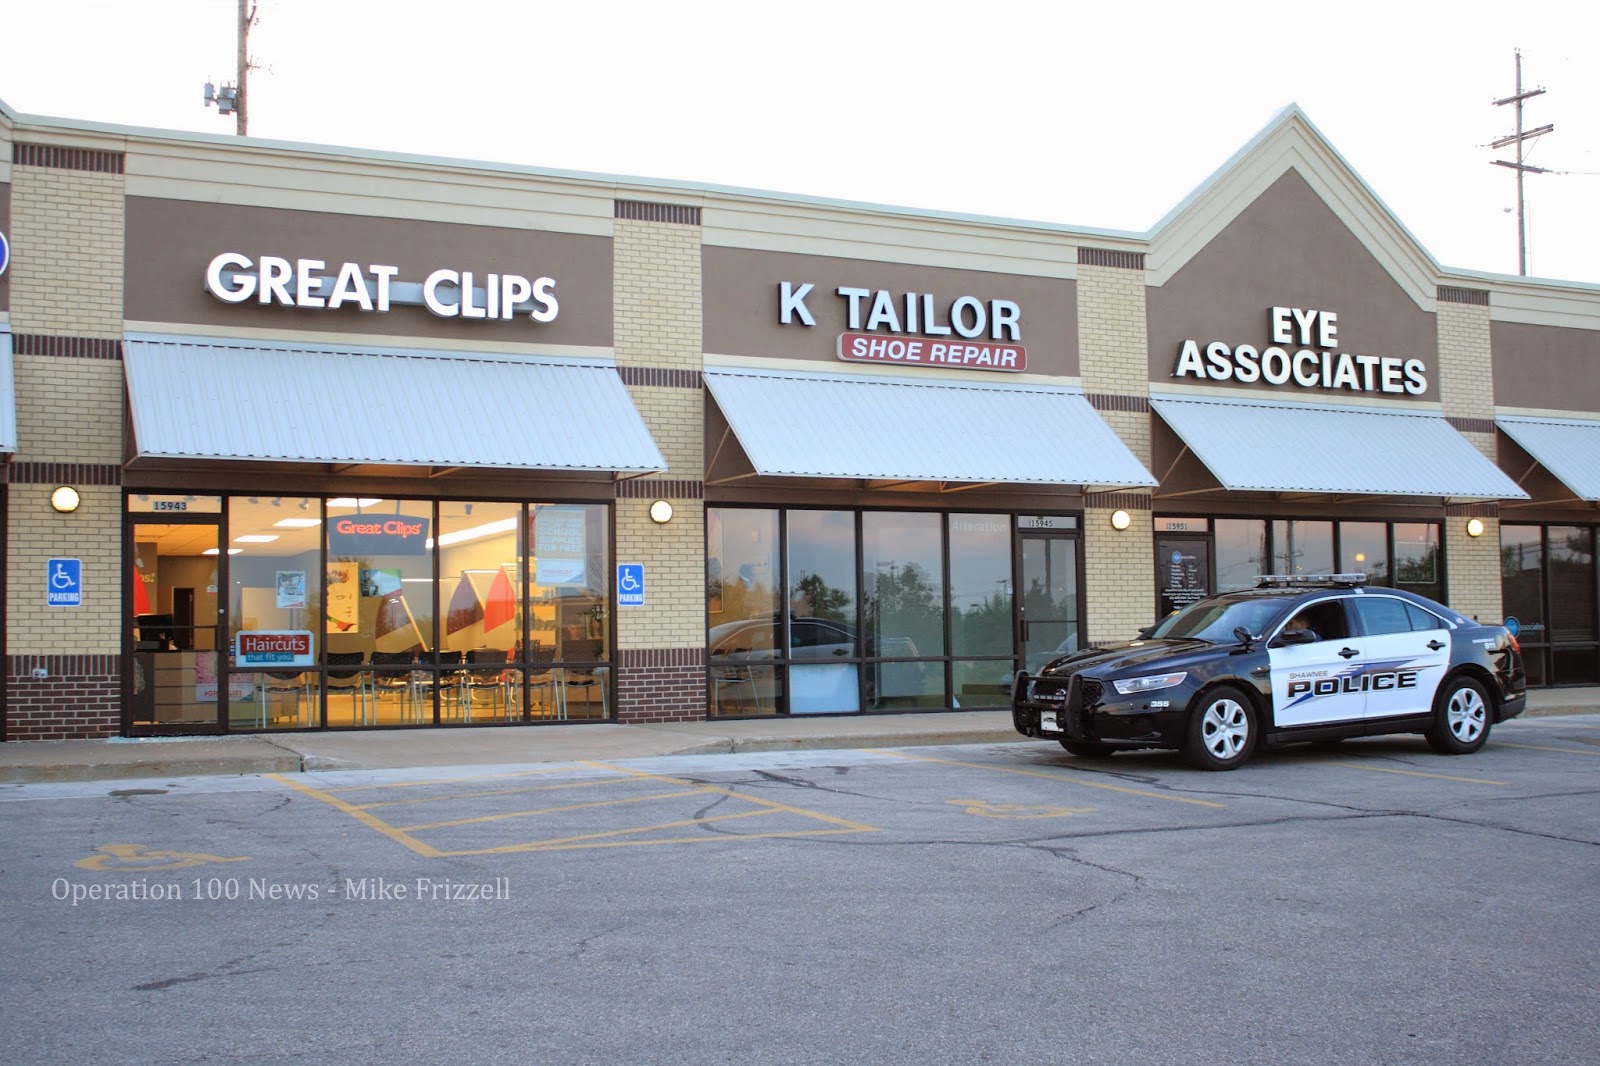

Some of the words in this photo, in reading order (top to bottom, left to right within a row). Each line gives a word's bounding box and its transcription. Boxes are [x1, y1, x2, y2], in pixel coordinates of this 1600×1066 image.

[206, 252, 399, 313] GREAT
[423, 268, 560, 323] CLIPS
[778, 281, 817, 326] K
[835, 286, 1022, 341] TAILOR
[1268, 306, 1339, 348] EYE
[851, 337, 923, 361] SHOE
[929, 343, 1018, 367] REPAIR
[1174, 339, 1428, 396] ASSOCIATES
[153, 501, 187, 511] 15943
[336, 519, 382, 535] Great
[1030, 520, 1053, 528] 15945
[1167, 522, 1188, 530] 15951
[49, 592, 80, 602] PARKING
[619, 594, 643, 603] PARKING
[246, 638, 306, 651] Haircuts
[247, 652, 263, 661] that
[265, 652, 275, 661] fit
[1289, 671, 1328, 679] SHAWNEE
[1287, 671, 1417, 699] POLICE
